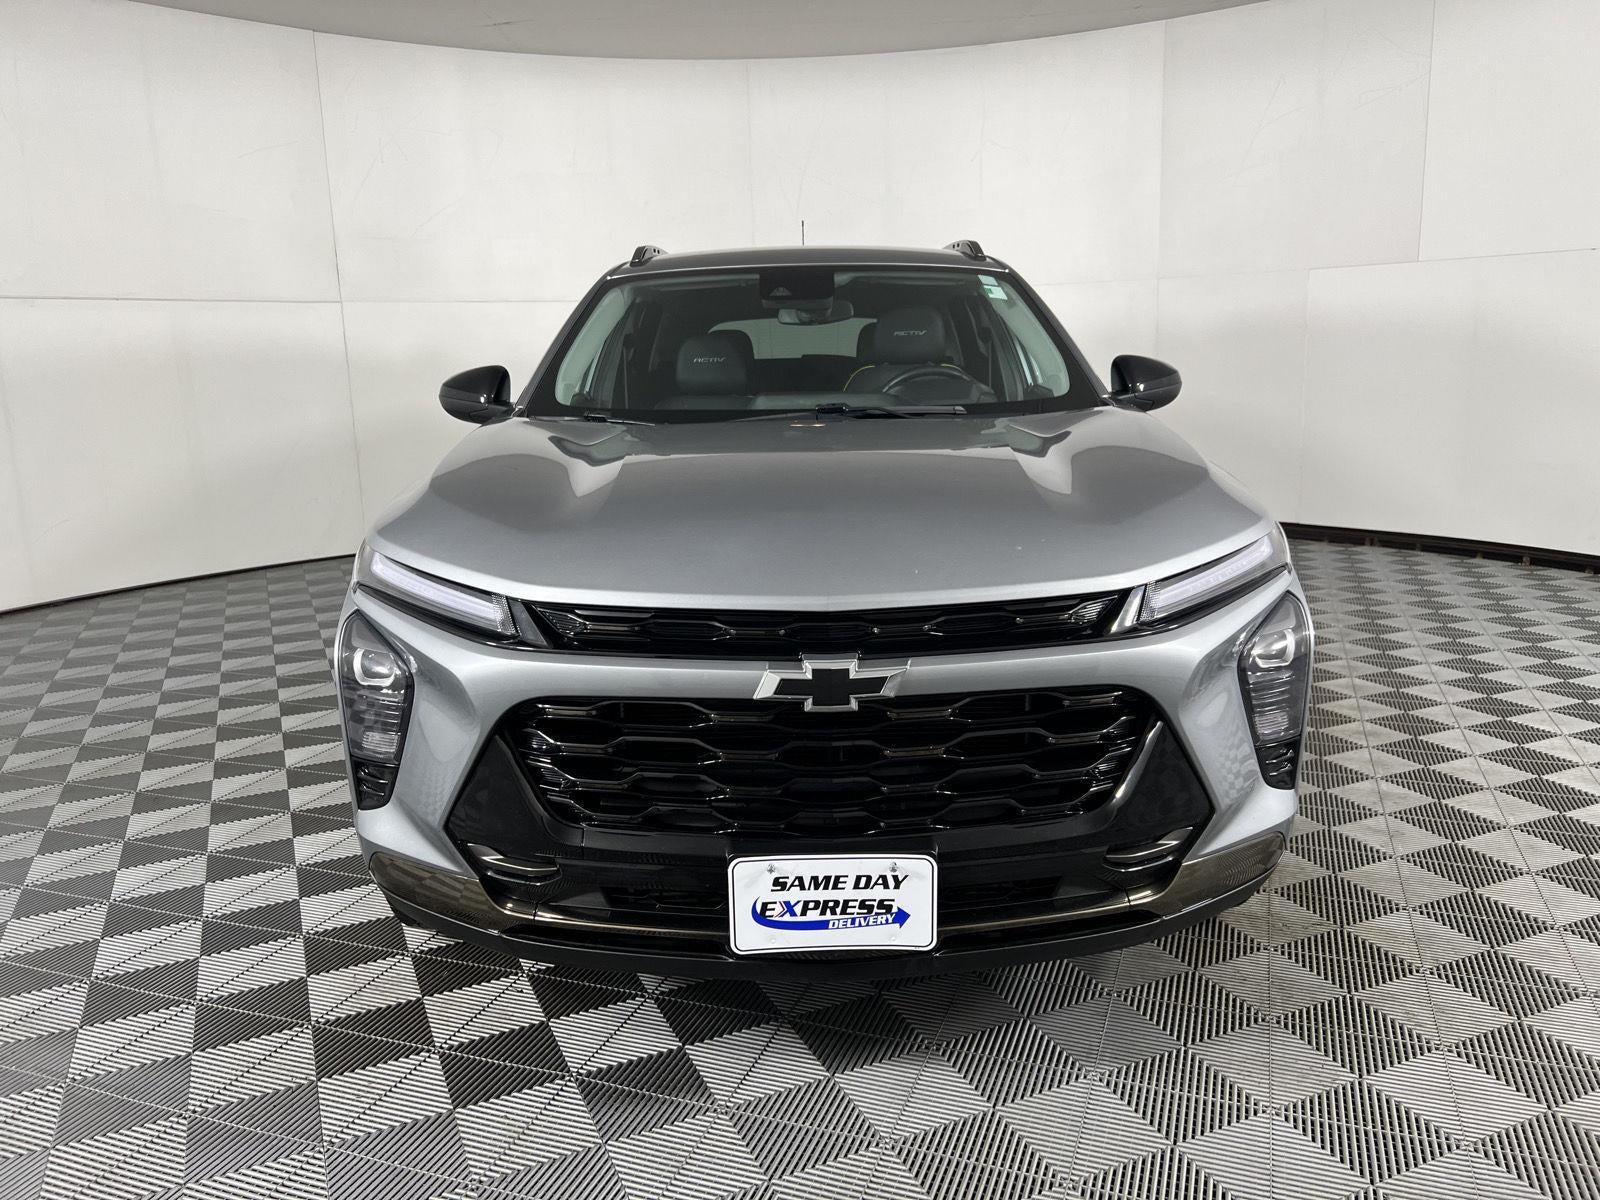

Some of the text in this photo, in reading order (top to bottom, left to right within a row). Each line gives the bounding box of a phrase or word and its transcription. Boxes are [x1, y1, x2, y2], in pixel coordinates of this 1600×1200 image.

[893, 328, 928, 337] ACTIV
[771, 874, 909, 892] SAME DAY
[759, 898, 896, 918] EXPRESS
[828, 913, 896, 930] DELIVERY
